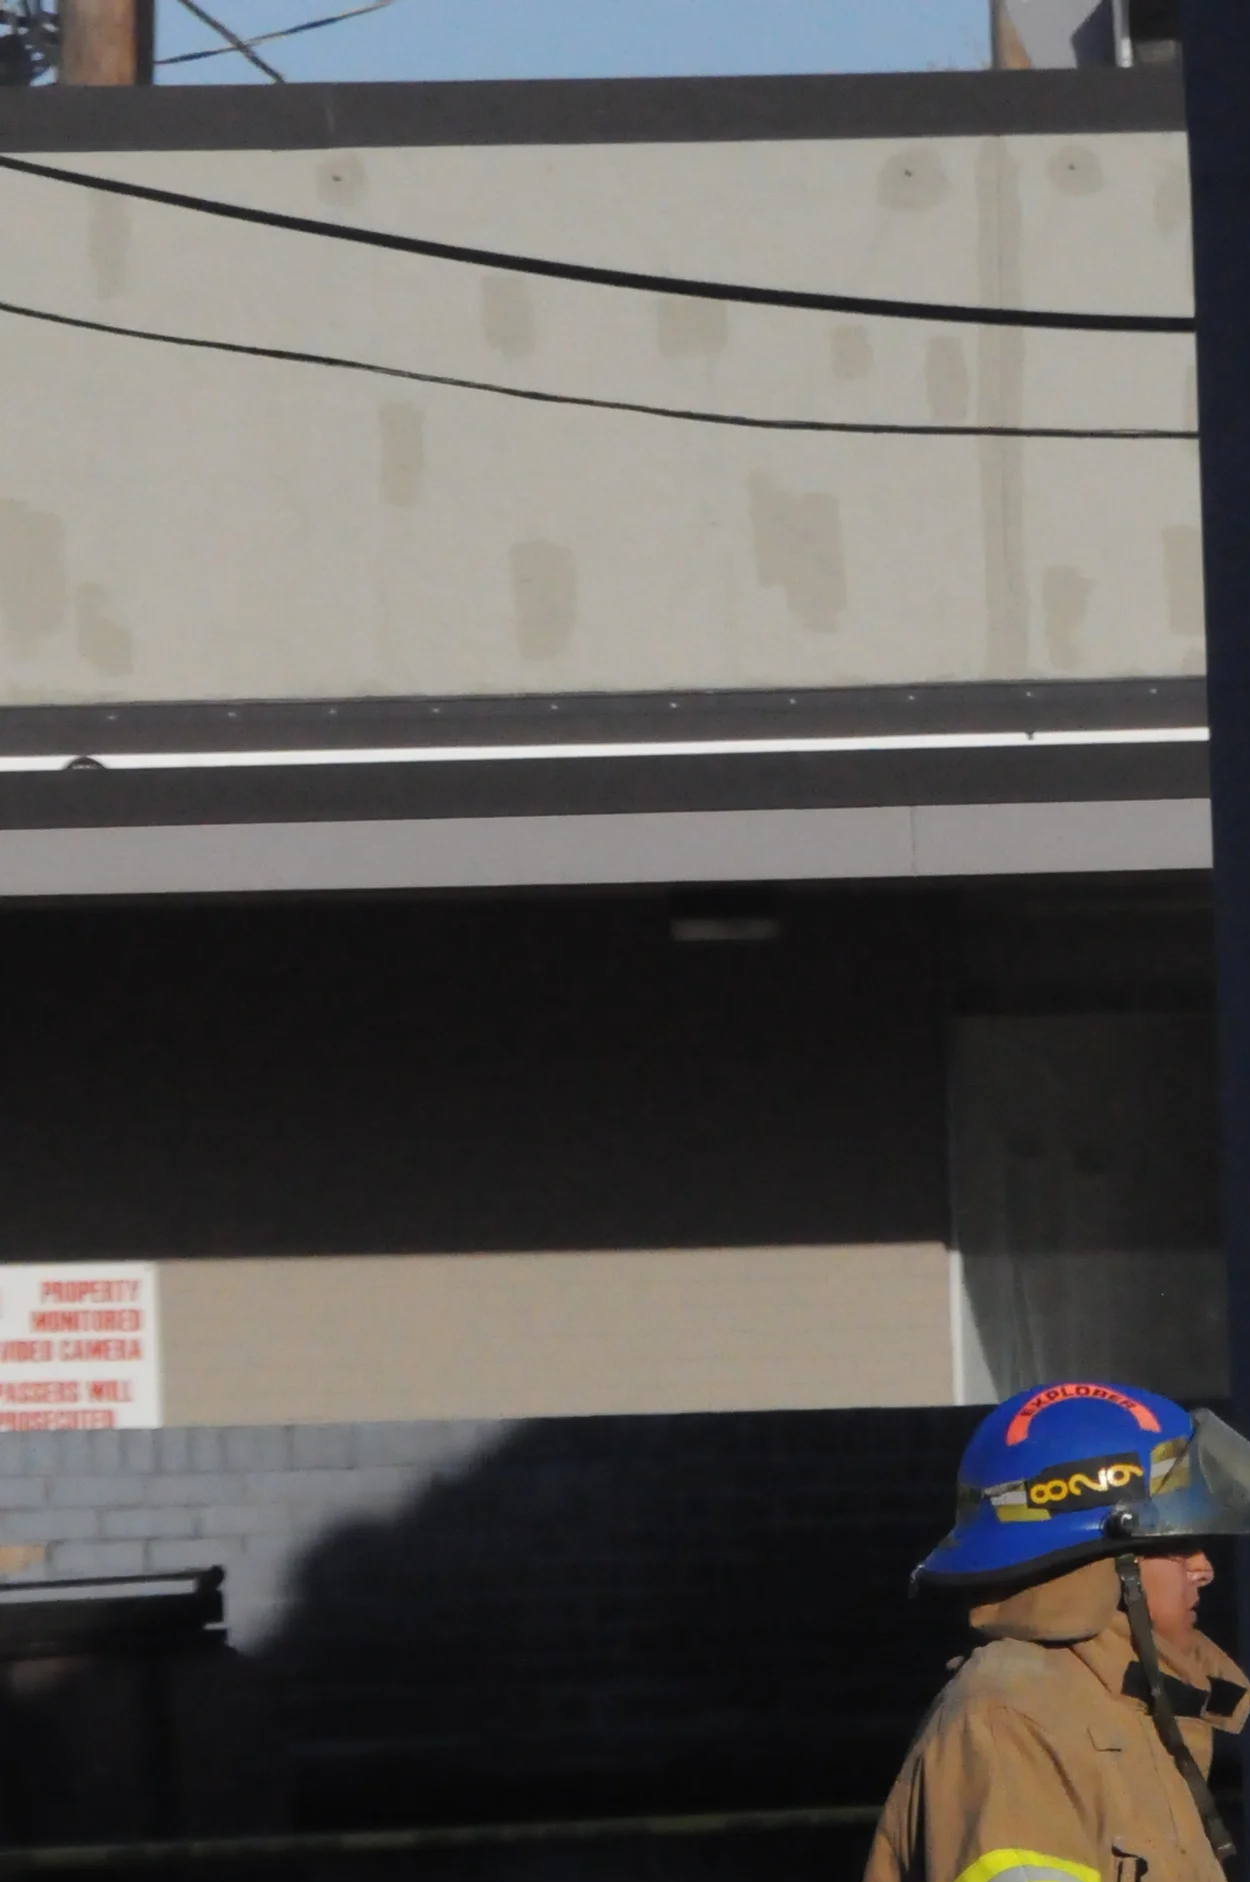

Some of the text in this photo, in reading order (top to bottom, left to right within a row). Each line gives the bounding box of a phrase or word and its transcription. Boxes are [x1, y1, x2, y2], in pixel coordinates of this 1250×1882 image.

[41, 1280, 139, 1304] PROPERTY
[31, 1311, 141, 1333] MONITORED
[61, 1339, 140, 1361] CAMERA
[90, 1380, 131, 1402] WILL
[1020, 1386, 1137, 1416] EXPLORER
